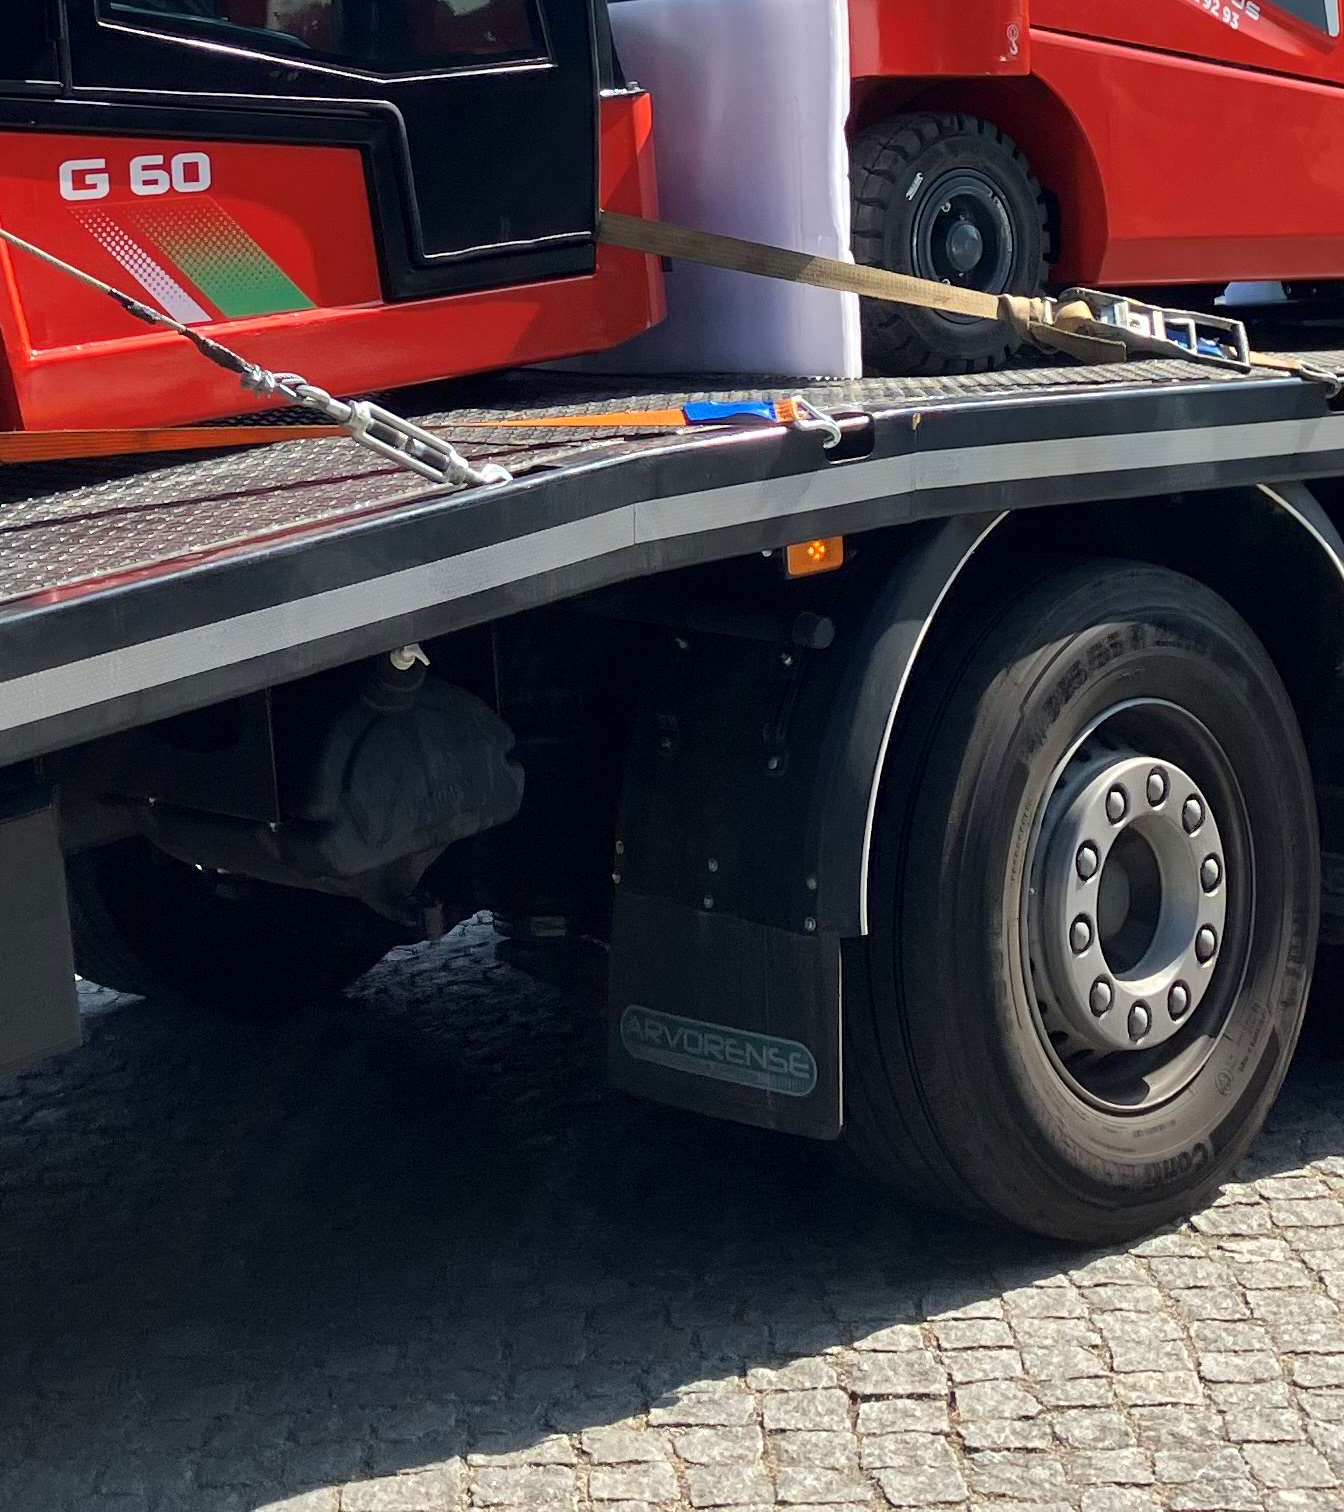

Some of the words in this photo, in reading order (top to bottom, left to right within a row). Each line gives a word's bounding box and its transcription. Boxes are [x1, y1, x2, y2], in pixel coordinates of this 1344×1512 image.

[1222, 7, 1240, 30] 93
[58, 157, 110, 201] G
[129, 151, 211, 196] 60
